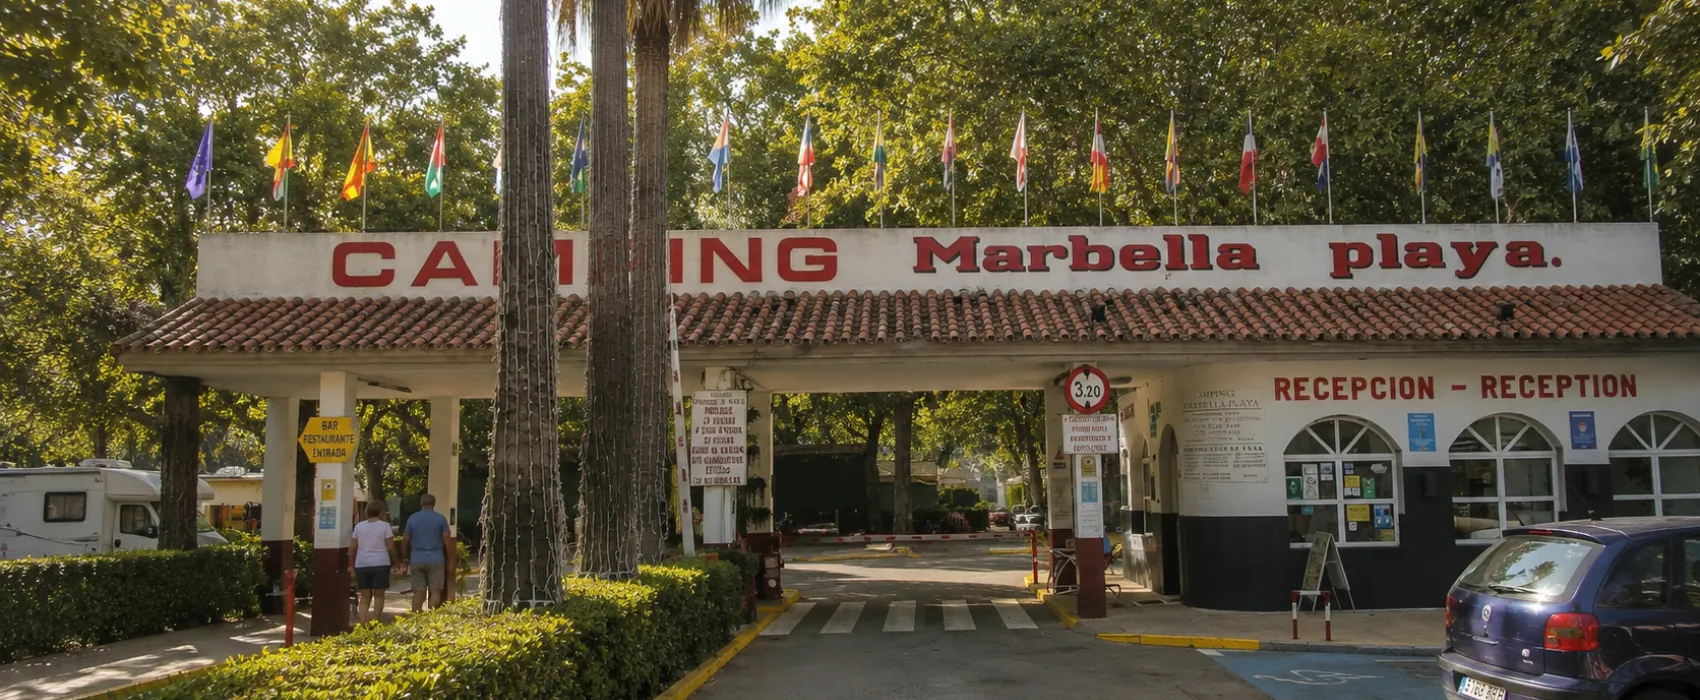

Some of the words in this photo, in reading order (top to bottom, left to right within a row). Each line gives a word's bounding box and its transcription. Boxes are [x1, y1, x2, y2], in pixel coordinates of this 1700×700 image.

[332, 237, 838, 287] CAING
[913, 234, 1260, 273] Marbella
[1329, 233, 1562, 279] playa.
[1075, 381, 1100, 398] 3.20
[1274, 376, 1435, 401] RECEPCION
[1481, 374, 1637, 399] RECEPTION
[322, 420, 339, 430] BAR
[303, 434, 355, 444] RESTAURANTE
[312, 448, 346, 458] ENTRADA
